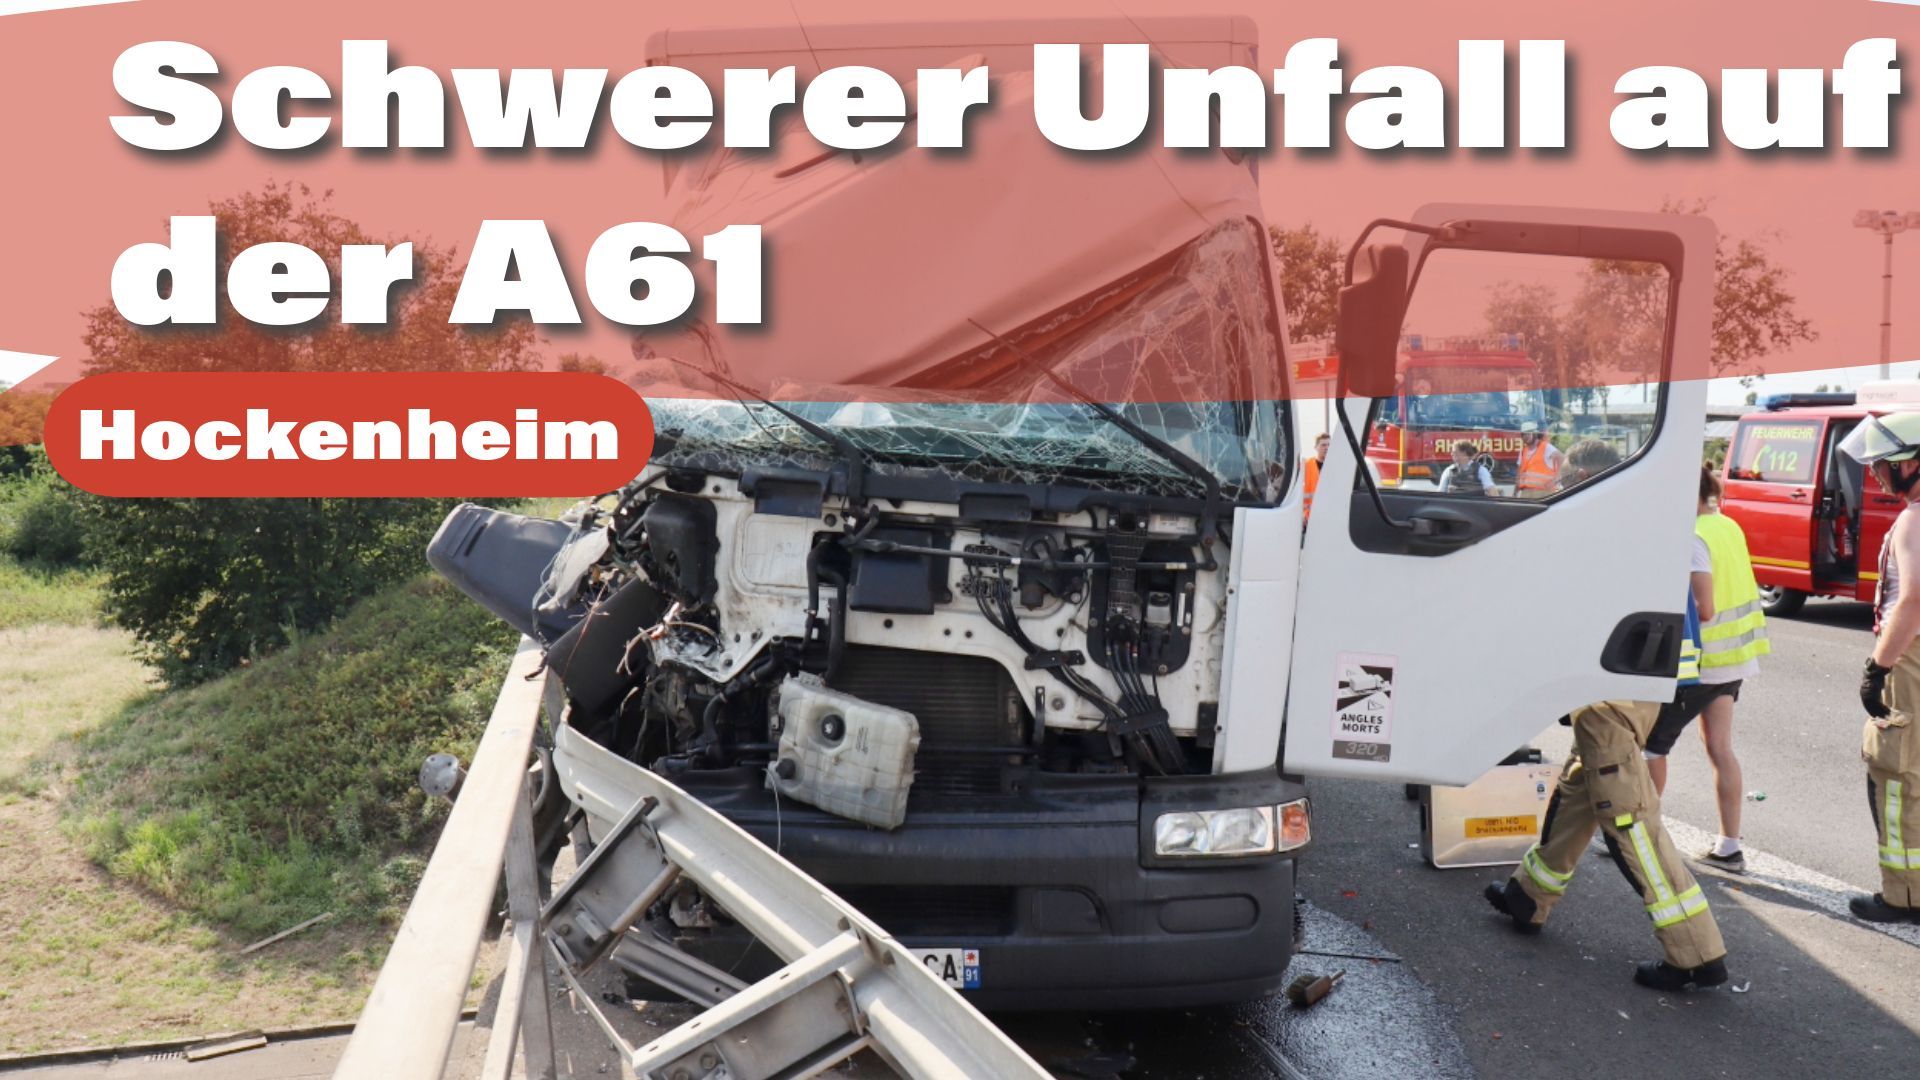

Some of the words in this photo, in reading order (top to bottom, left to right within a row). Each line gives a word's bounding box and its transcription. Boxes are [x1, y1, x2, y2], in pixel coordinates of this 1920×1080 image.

[1751, 427, 1814, 439] FEUERWEHR
[1769, 450, 1798, 471] 112
[1341, 713, 1383, 725] ANGLES
[1342, 723, 1380, 734] MORTS
[1346, 742, 1378, 756] 320
[965, 968, 978, 981] 91
